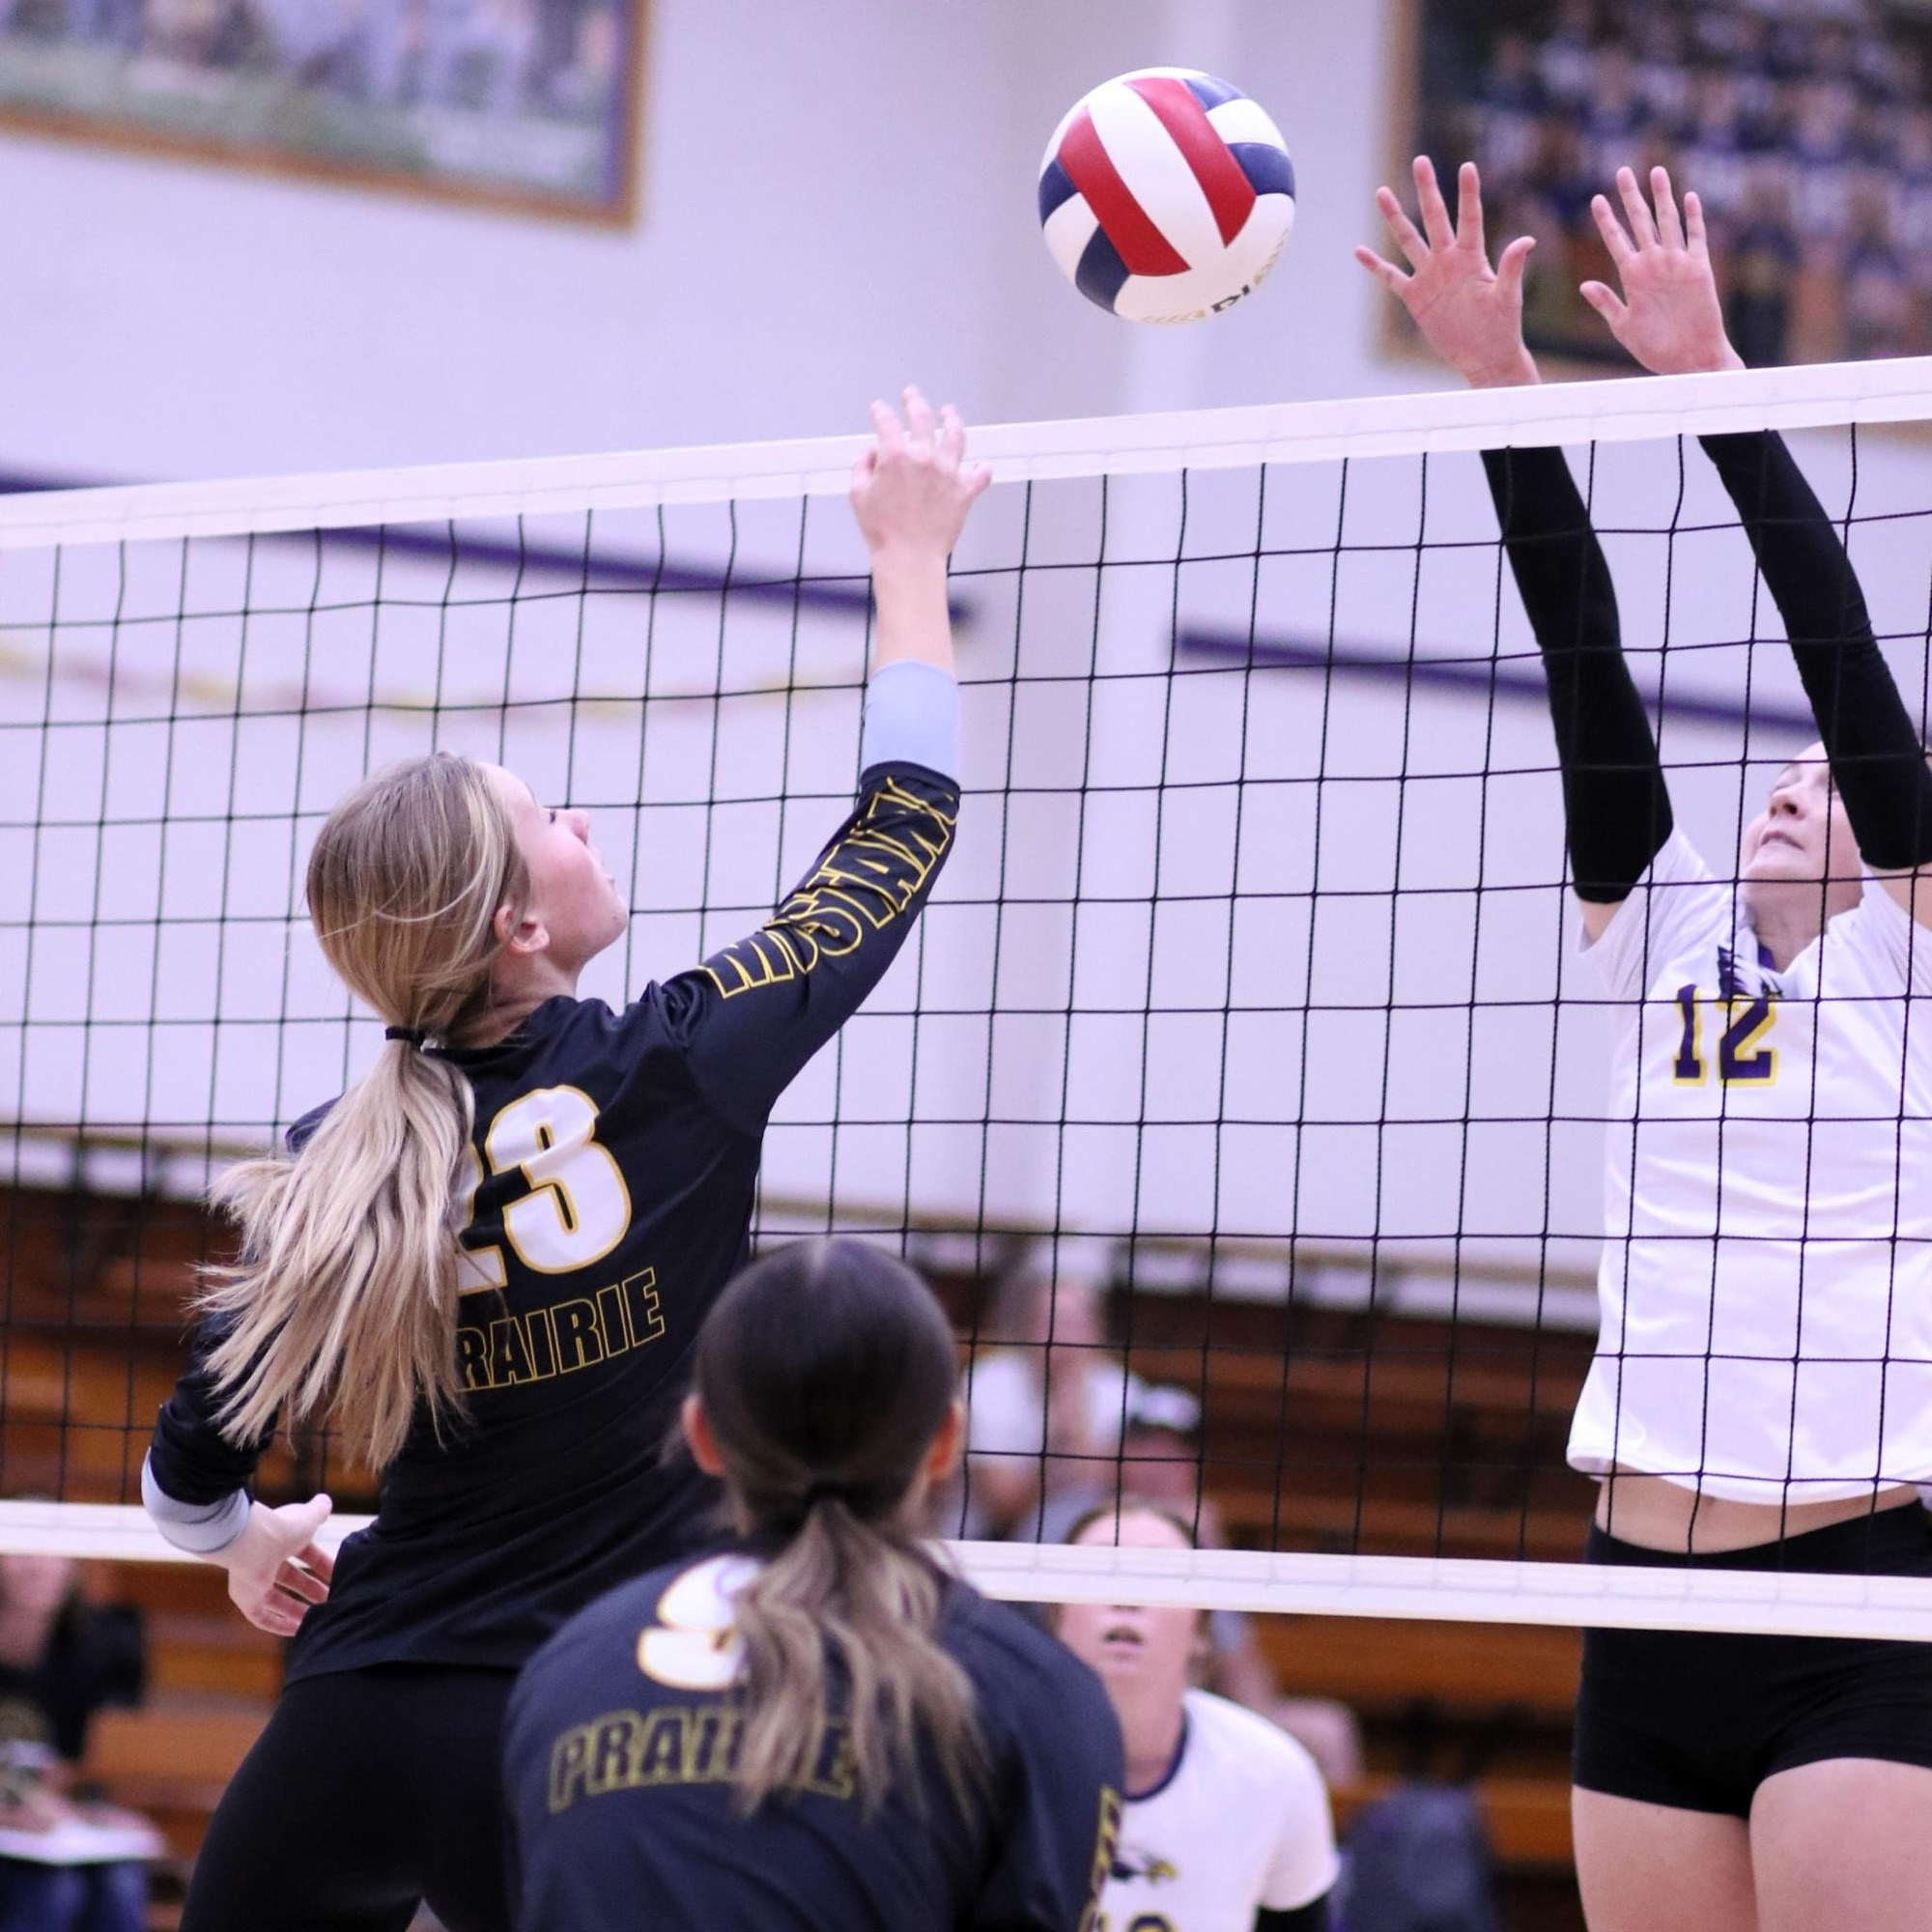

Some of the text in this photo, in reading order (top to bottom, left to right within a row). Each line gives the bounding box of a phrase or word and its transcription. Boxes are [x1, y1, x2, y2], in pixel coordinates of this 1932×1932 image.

[1671, 983, 1779, 1088] 12
[454, 1265, 667, 1394] RAIRIE
[547, 1704, 858, 1815] PRAIE
